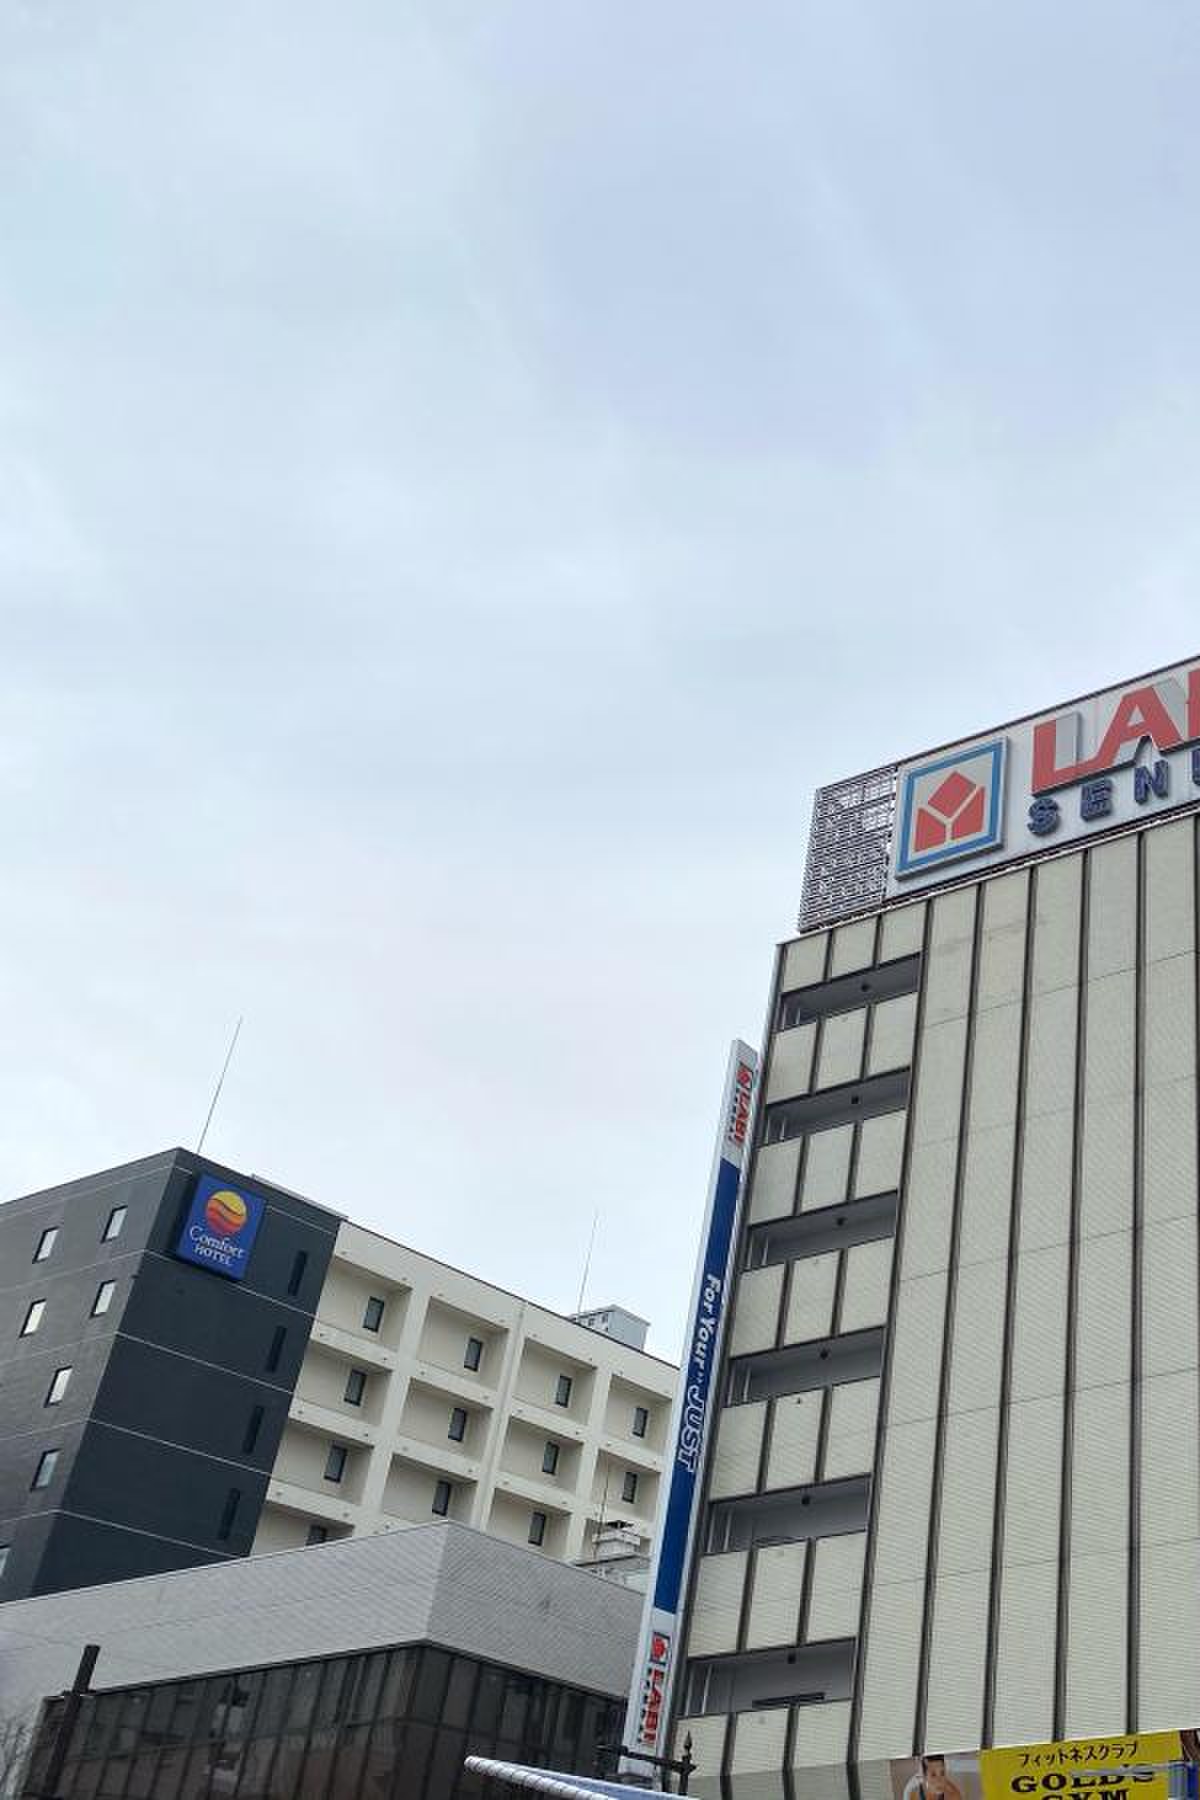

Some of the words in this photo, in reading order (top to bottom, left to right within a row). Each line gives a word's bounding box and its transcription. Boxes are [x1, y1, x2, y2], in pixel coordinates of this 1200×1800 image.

[704, 1273, 721, 1314] For
[693, 1316, 717, 1369] Your
[643, 1668, 664, 1742] LABI
[1018, 1741, 1138, 1767] フィットネスクラブ
